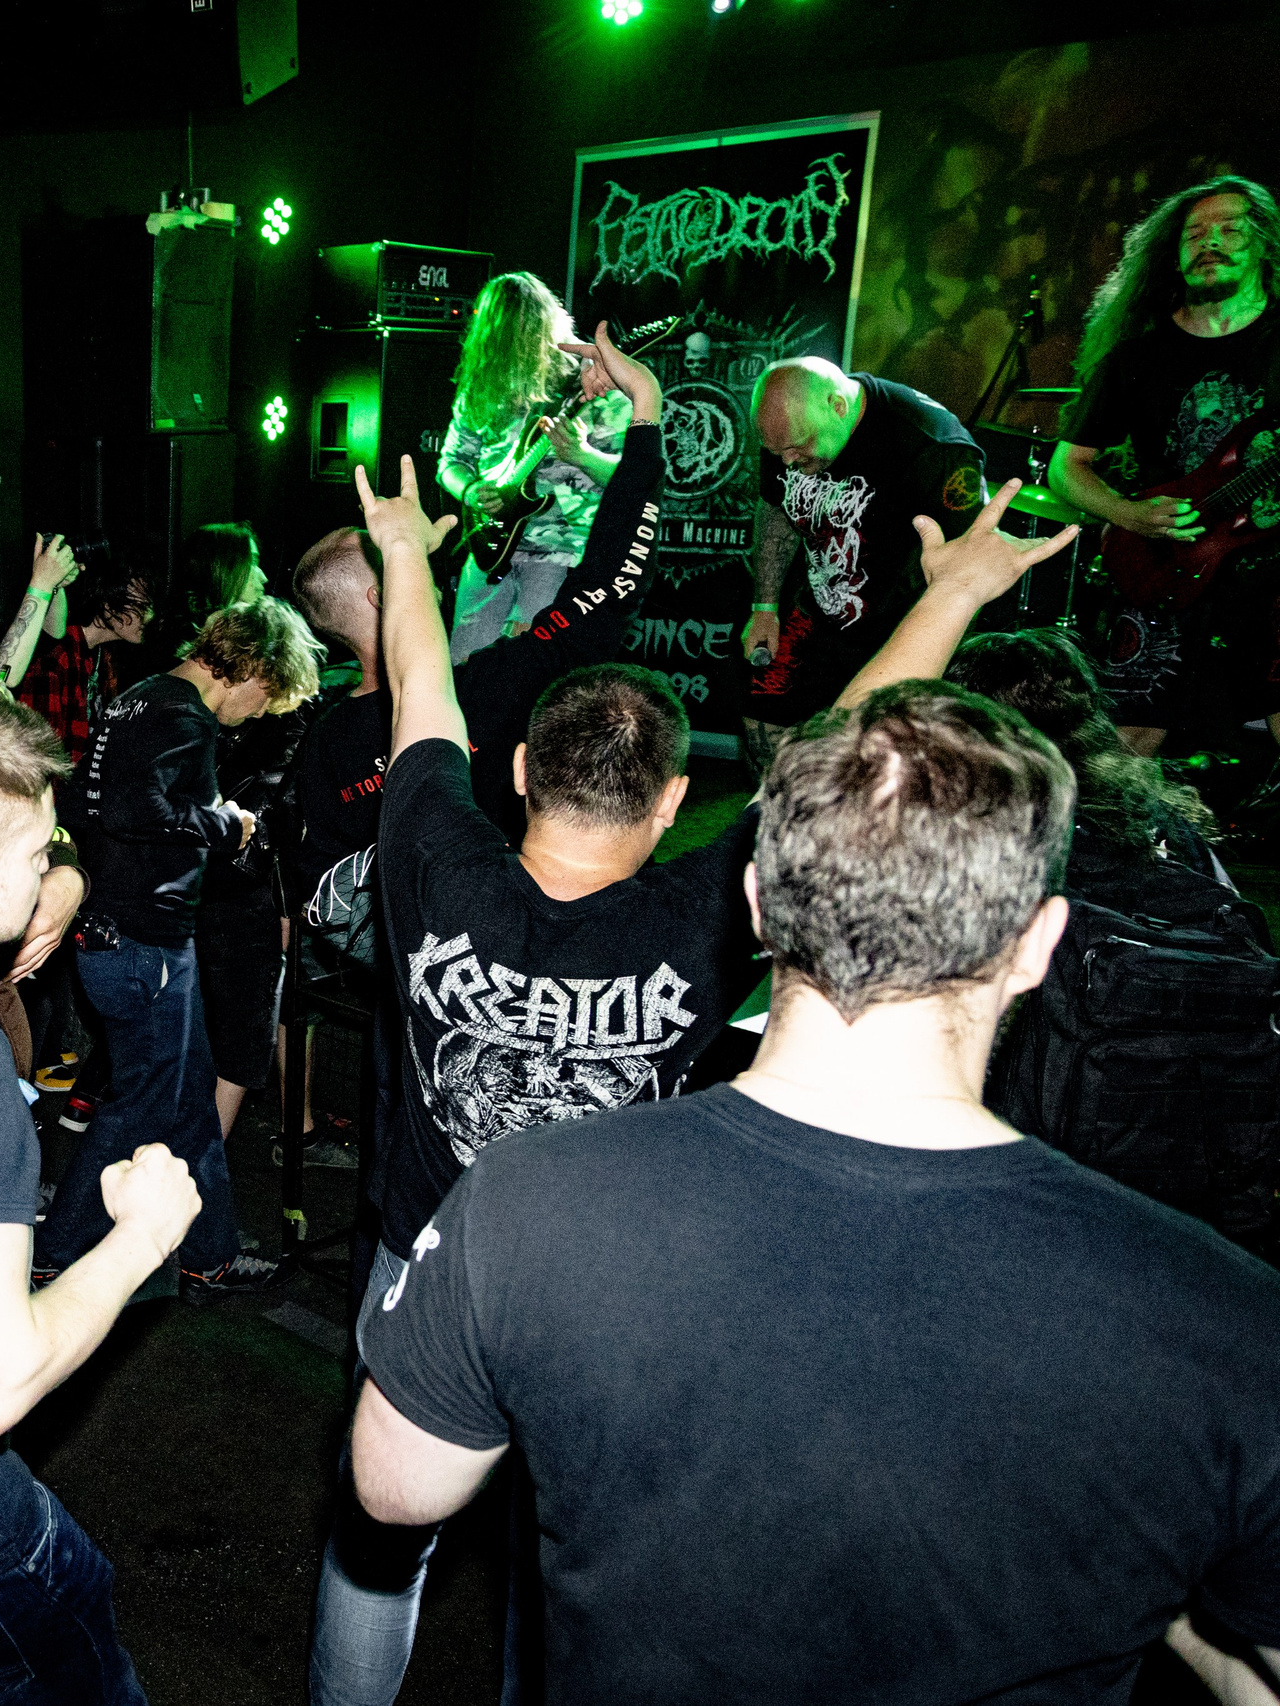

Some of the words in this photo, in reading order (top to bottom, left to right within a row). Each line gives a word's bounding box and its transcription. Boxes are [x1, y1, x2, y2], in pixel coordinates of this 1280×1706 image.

[418, 264, 450, 289] ENGL
[682, 521, 747, 546] MACHINE
[621, 617, 734, 659] SINCE
[407, 931, 698, 1056] KREATOR
